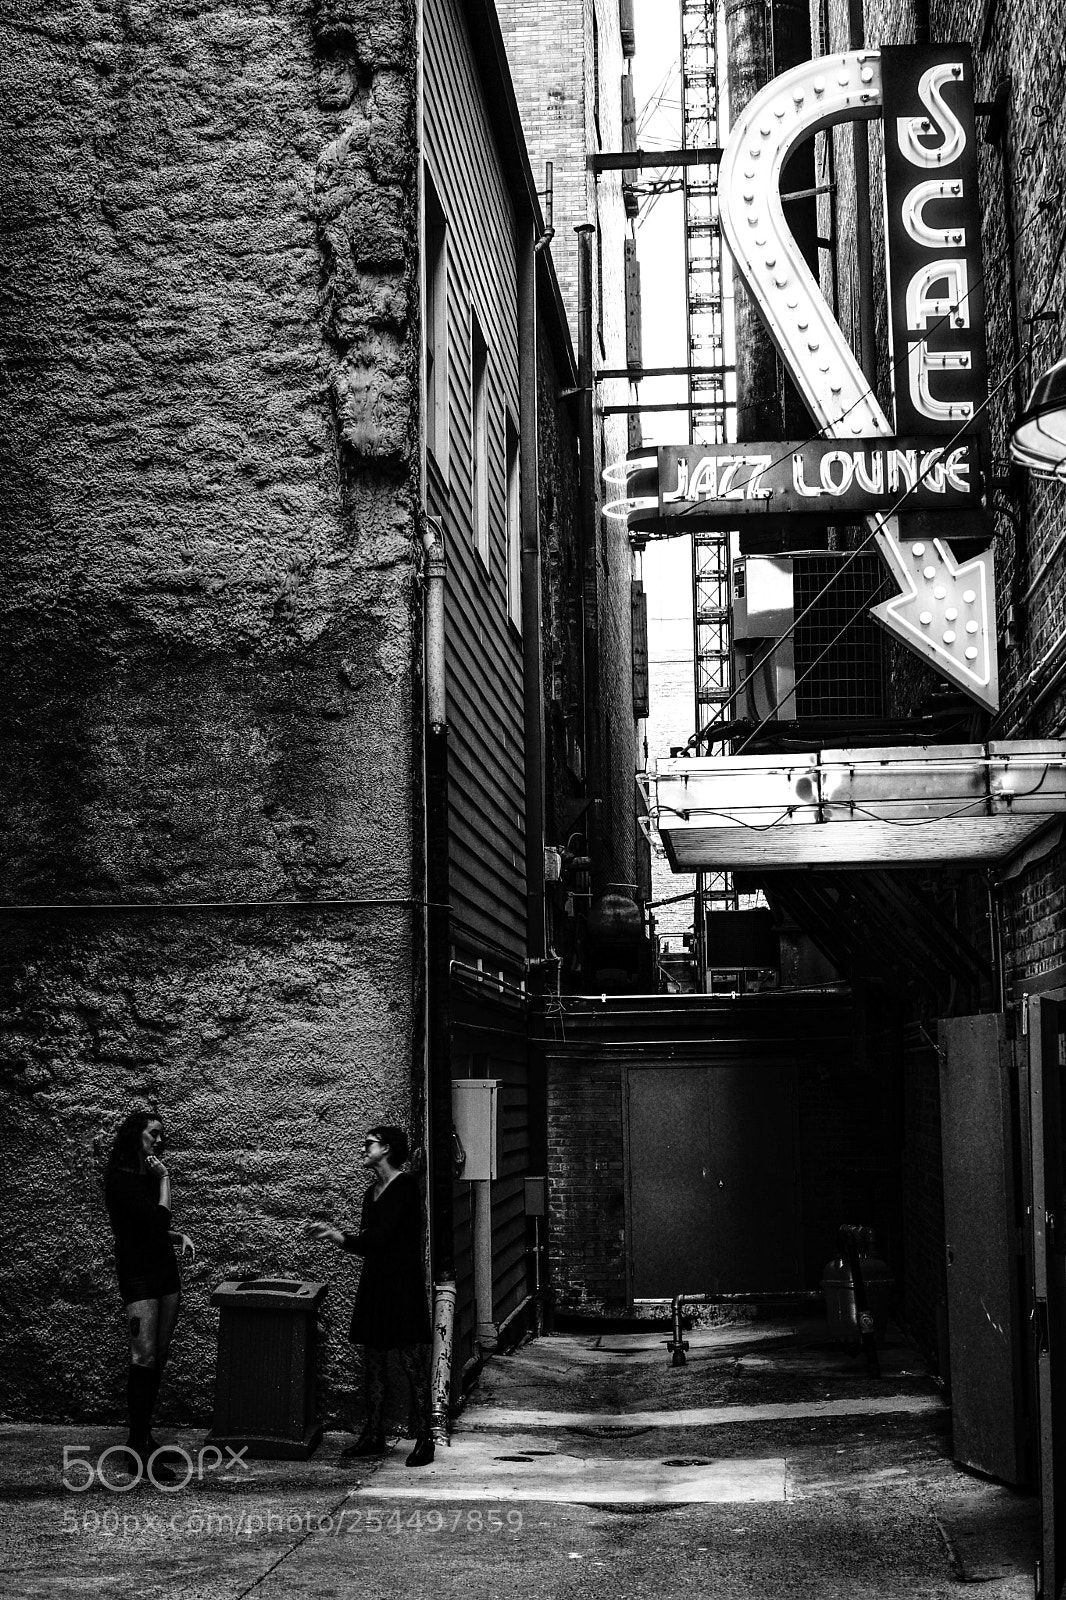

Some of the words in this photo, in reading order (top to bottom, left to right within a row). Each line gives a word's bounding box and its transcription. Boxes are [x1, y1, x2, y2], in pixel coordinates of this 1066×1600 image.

[896, 62, 974, 421] SCAT
[662, 454, 773, 503] JAZZ
[792, 445, 970, 497] LOUNGE
